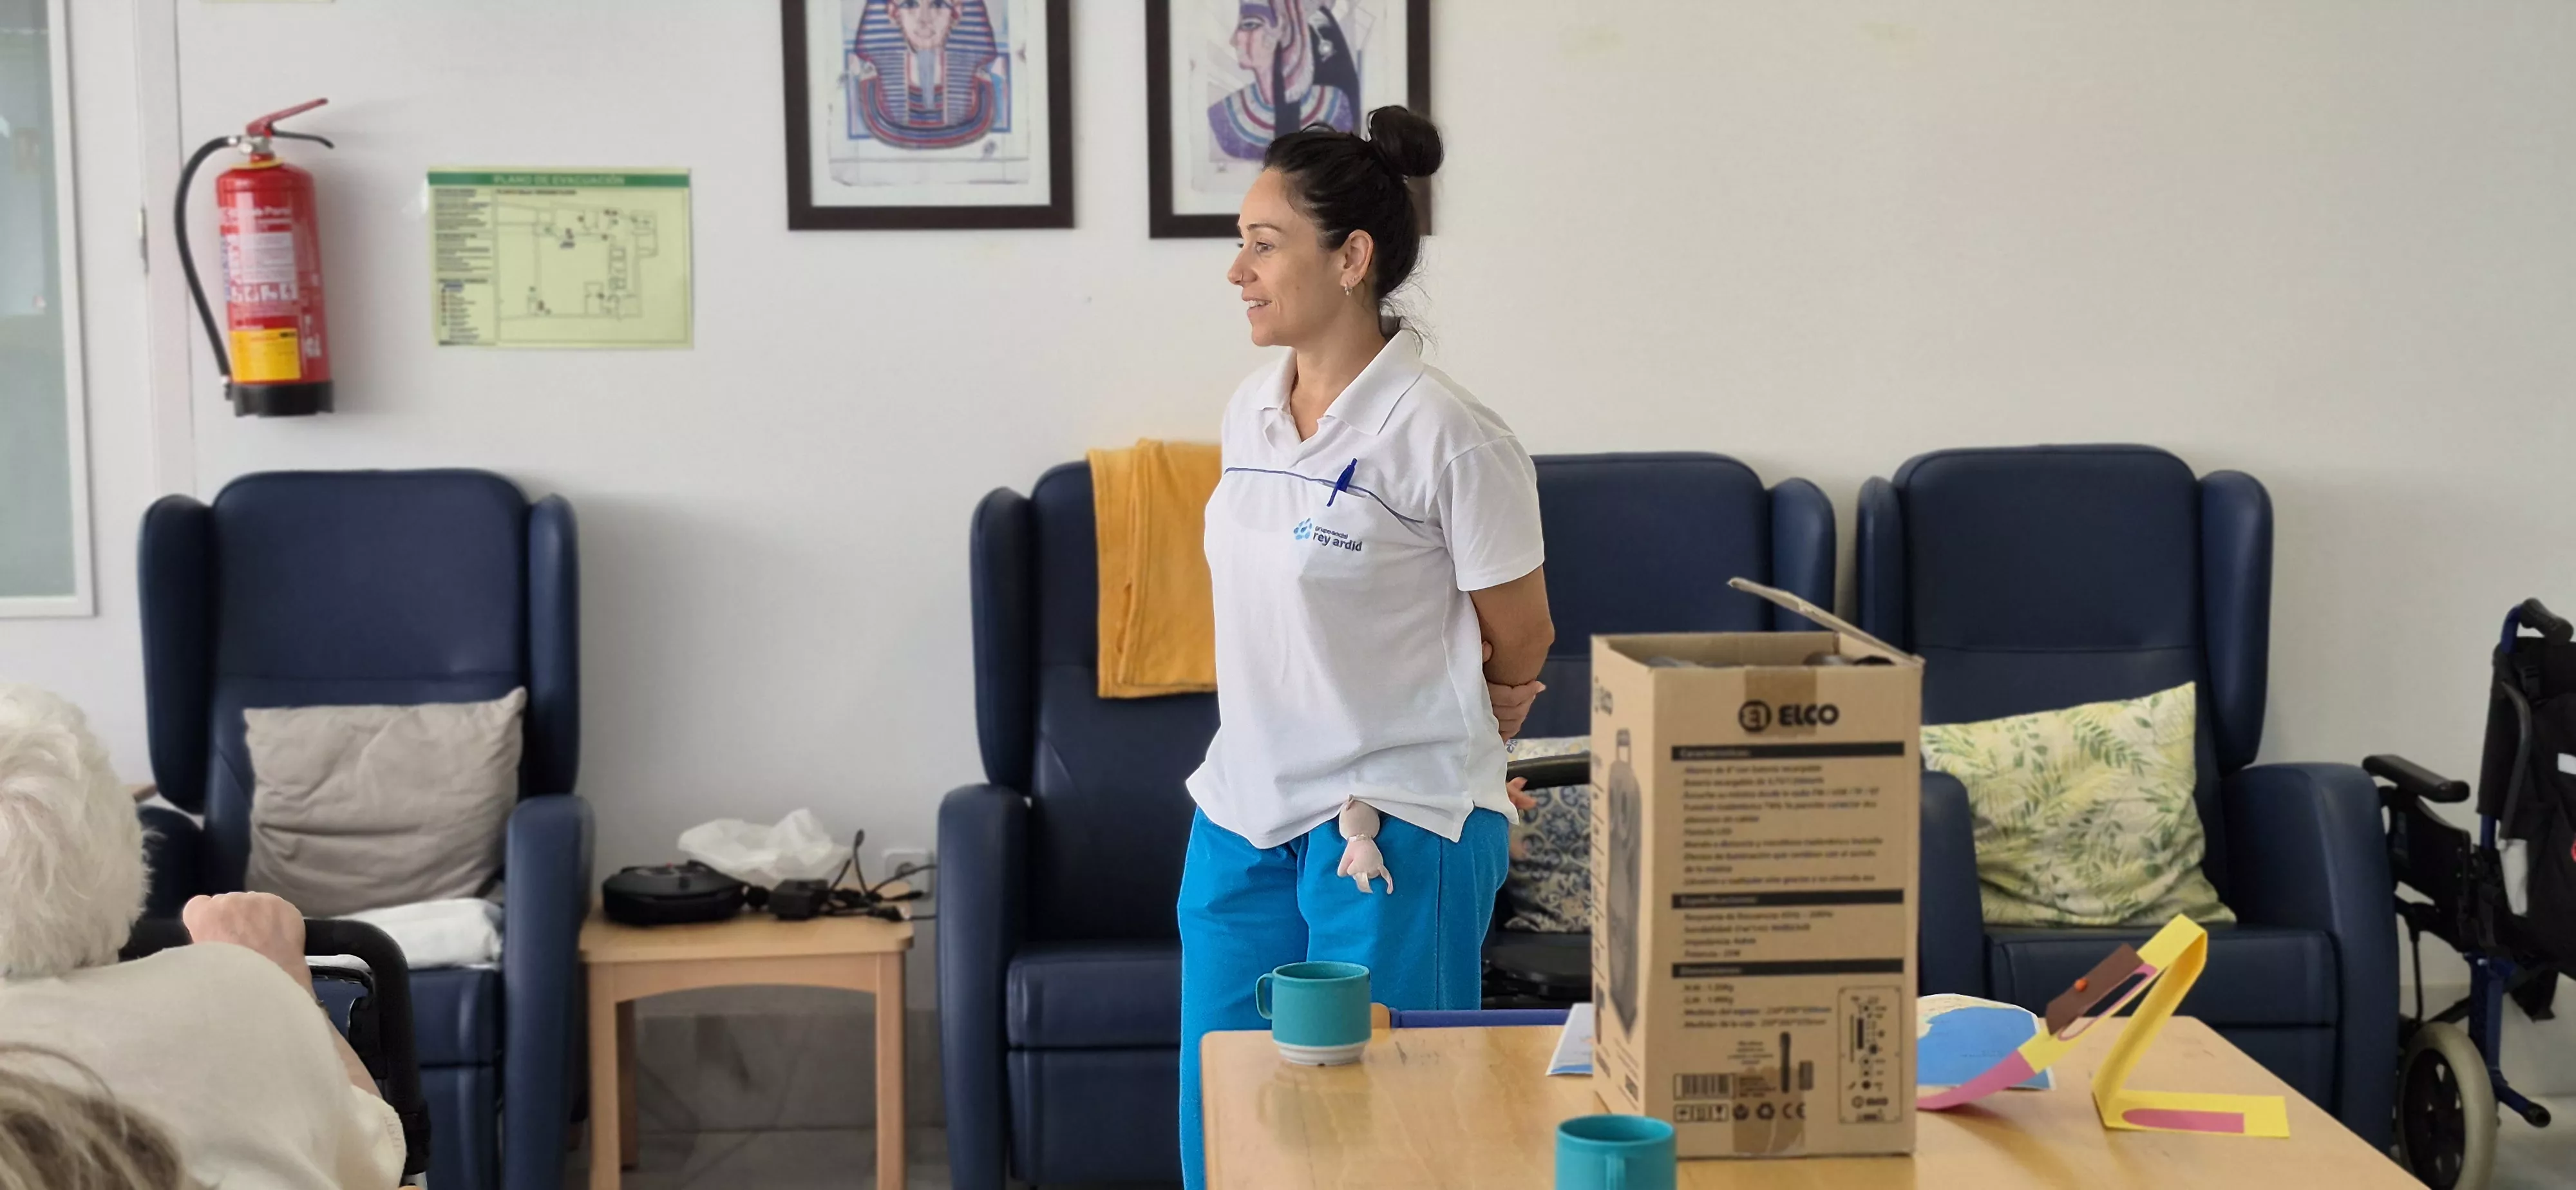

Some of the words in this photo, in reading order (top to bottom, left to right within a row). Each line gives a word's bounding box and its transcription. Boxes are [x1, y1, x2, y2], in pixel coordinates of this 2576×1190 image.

[493, 175, 532, 184] PLANO
[535, 175, 549, 185] DE
[1312, 532, 1331, 546] rey
[1332, 538, 1363, 551] ardid
[1778, 703, 1840, 726] ELCO
